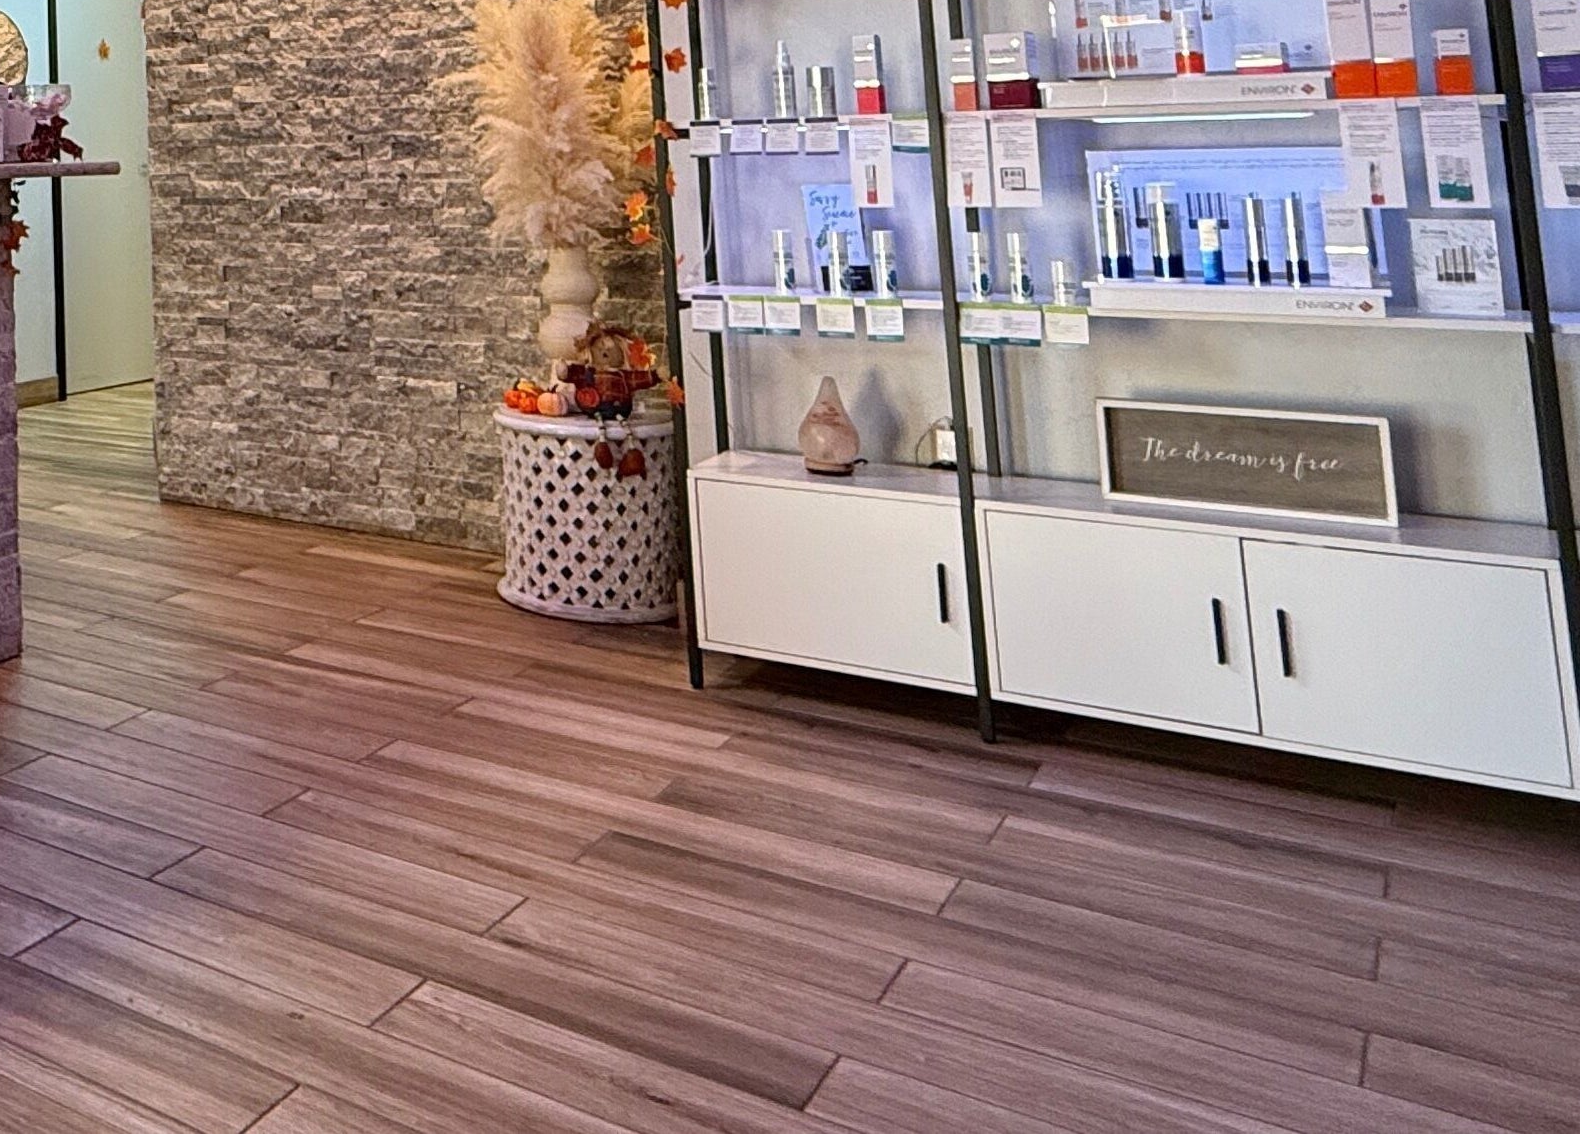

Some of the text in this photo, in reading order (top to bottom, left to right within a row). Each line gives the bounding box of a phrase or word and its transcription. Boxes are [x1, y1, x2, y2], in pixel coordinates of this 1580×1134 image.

[1140, 437, 1179, 462] The
[1182, 441, 1264, 468] dream
[1292, 452, 1339, 482] free
